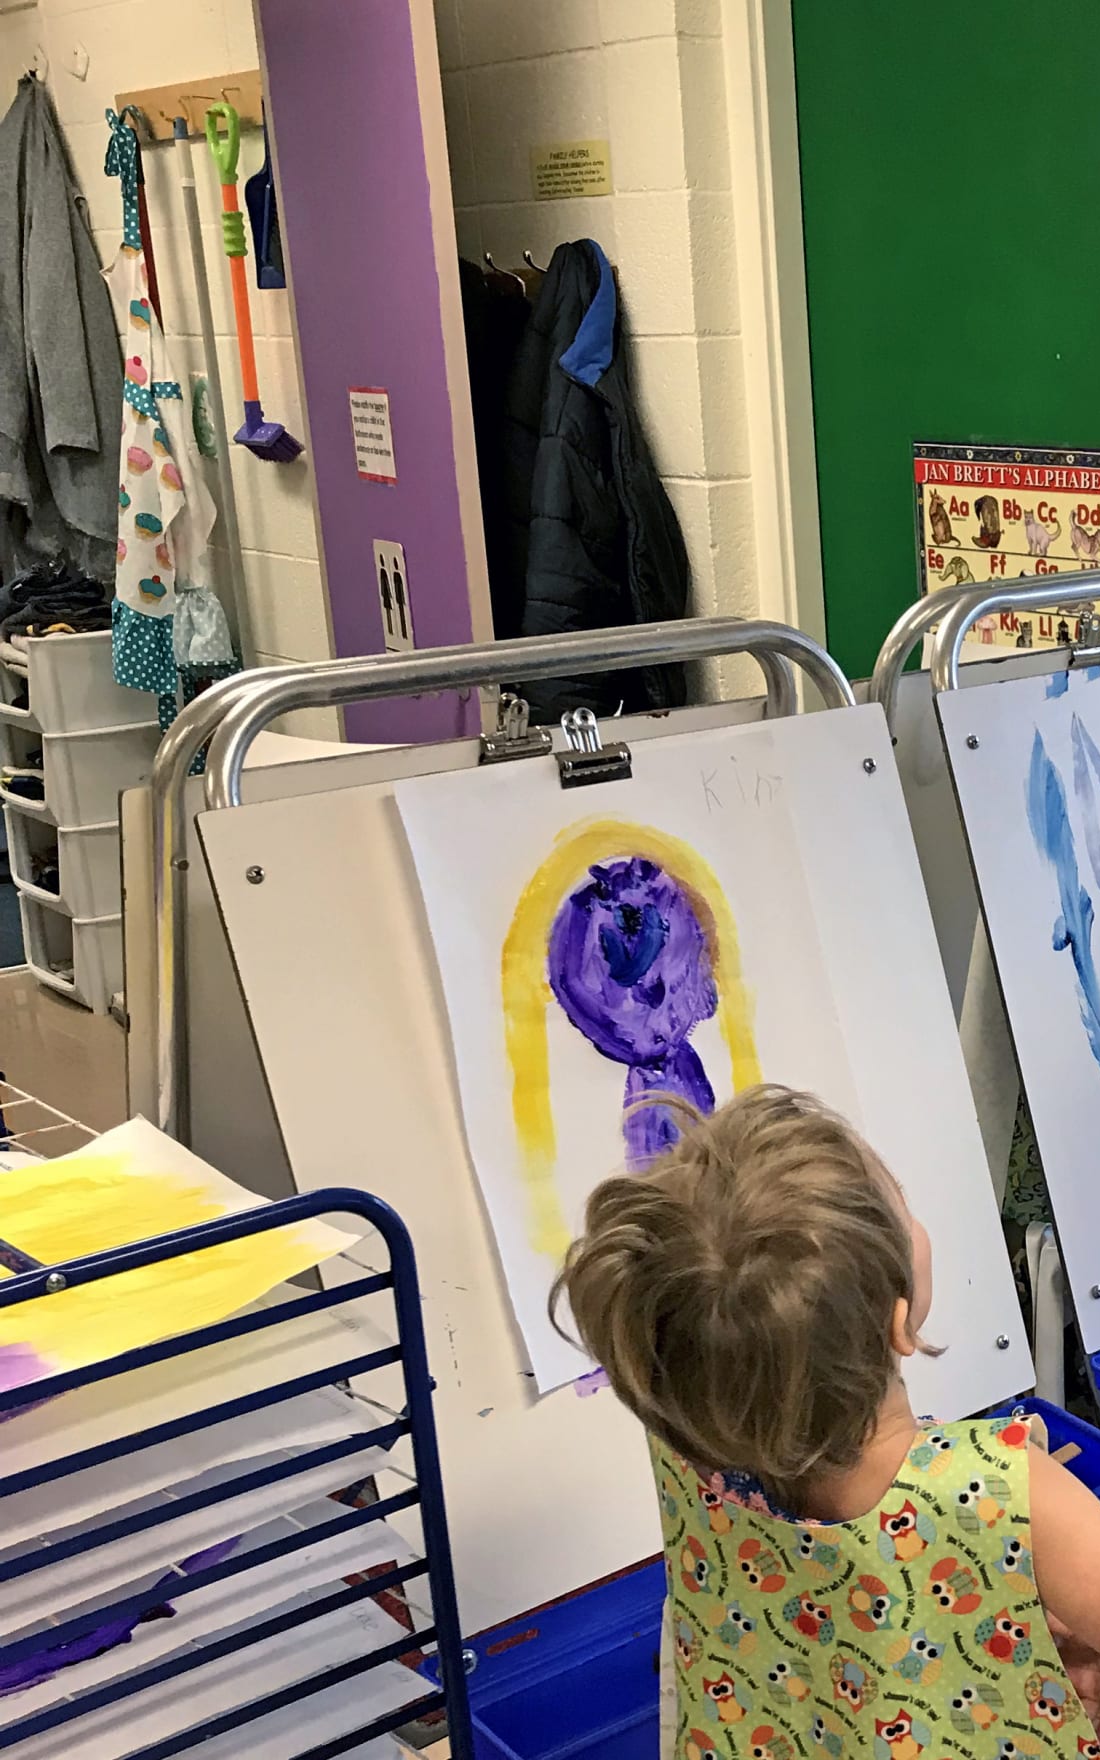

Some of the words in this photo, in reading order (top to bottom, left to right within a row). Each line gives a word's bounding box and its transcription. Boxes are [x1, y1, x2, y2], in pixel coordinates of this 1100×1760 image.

[922, 463, 949, 483] JAN
[954, 465, 1020, 485] BRETT'S
[949, 496, 970, 517] Aa
[1002, 499, 1022, 521] Bb
[1037, 501, 1058, 523] Cc
[1077, 504, 1100, 526] Dd
[928, 549, 945, 570] Ee
[990, 554, 1007, 575] Ff
[1000, 612, 1020, 633] Kk
